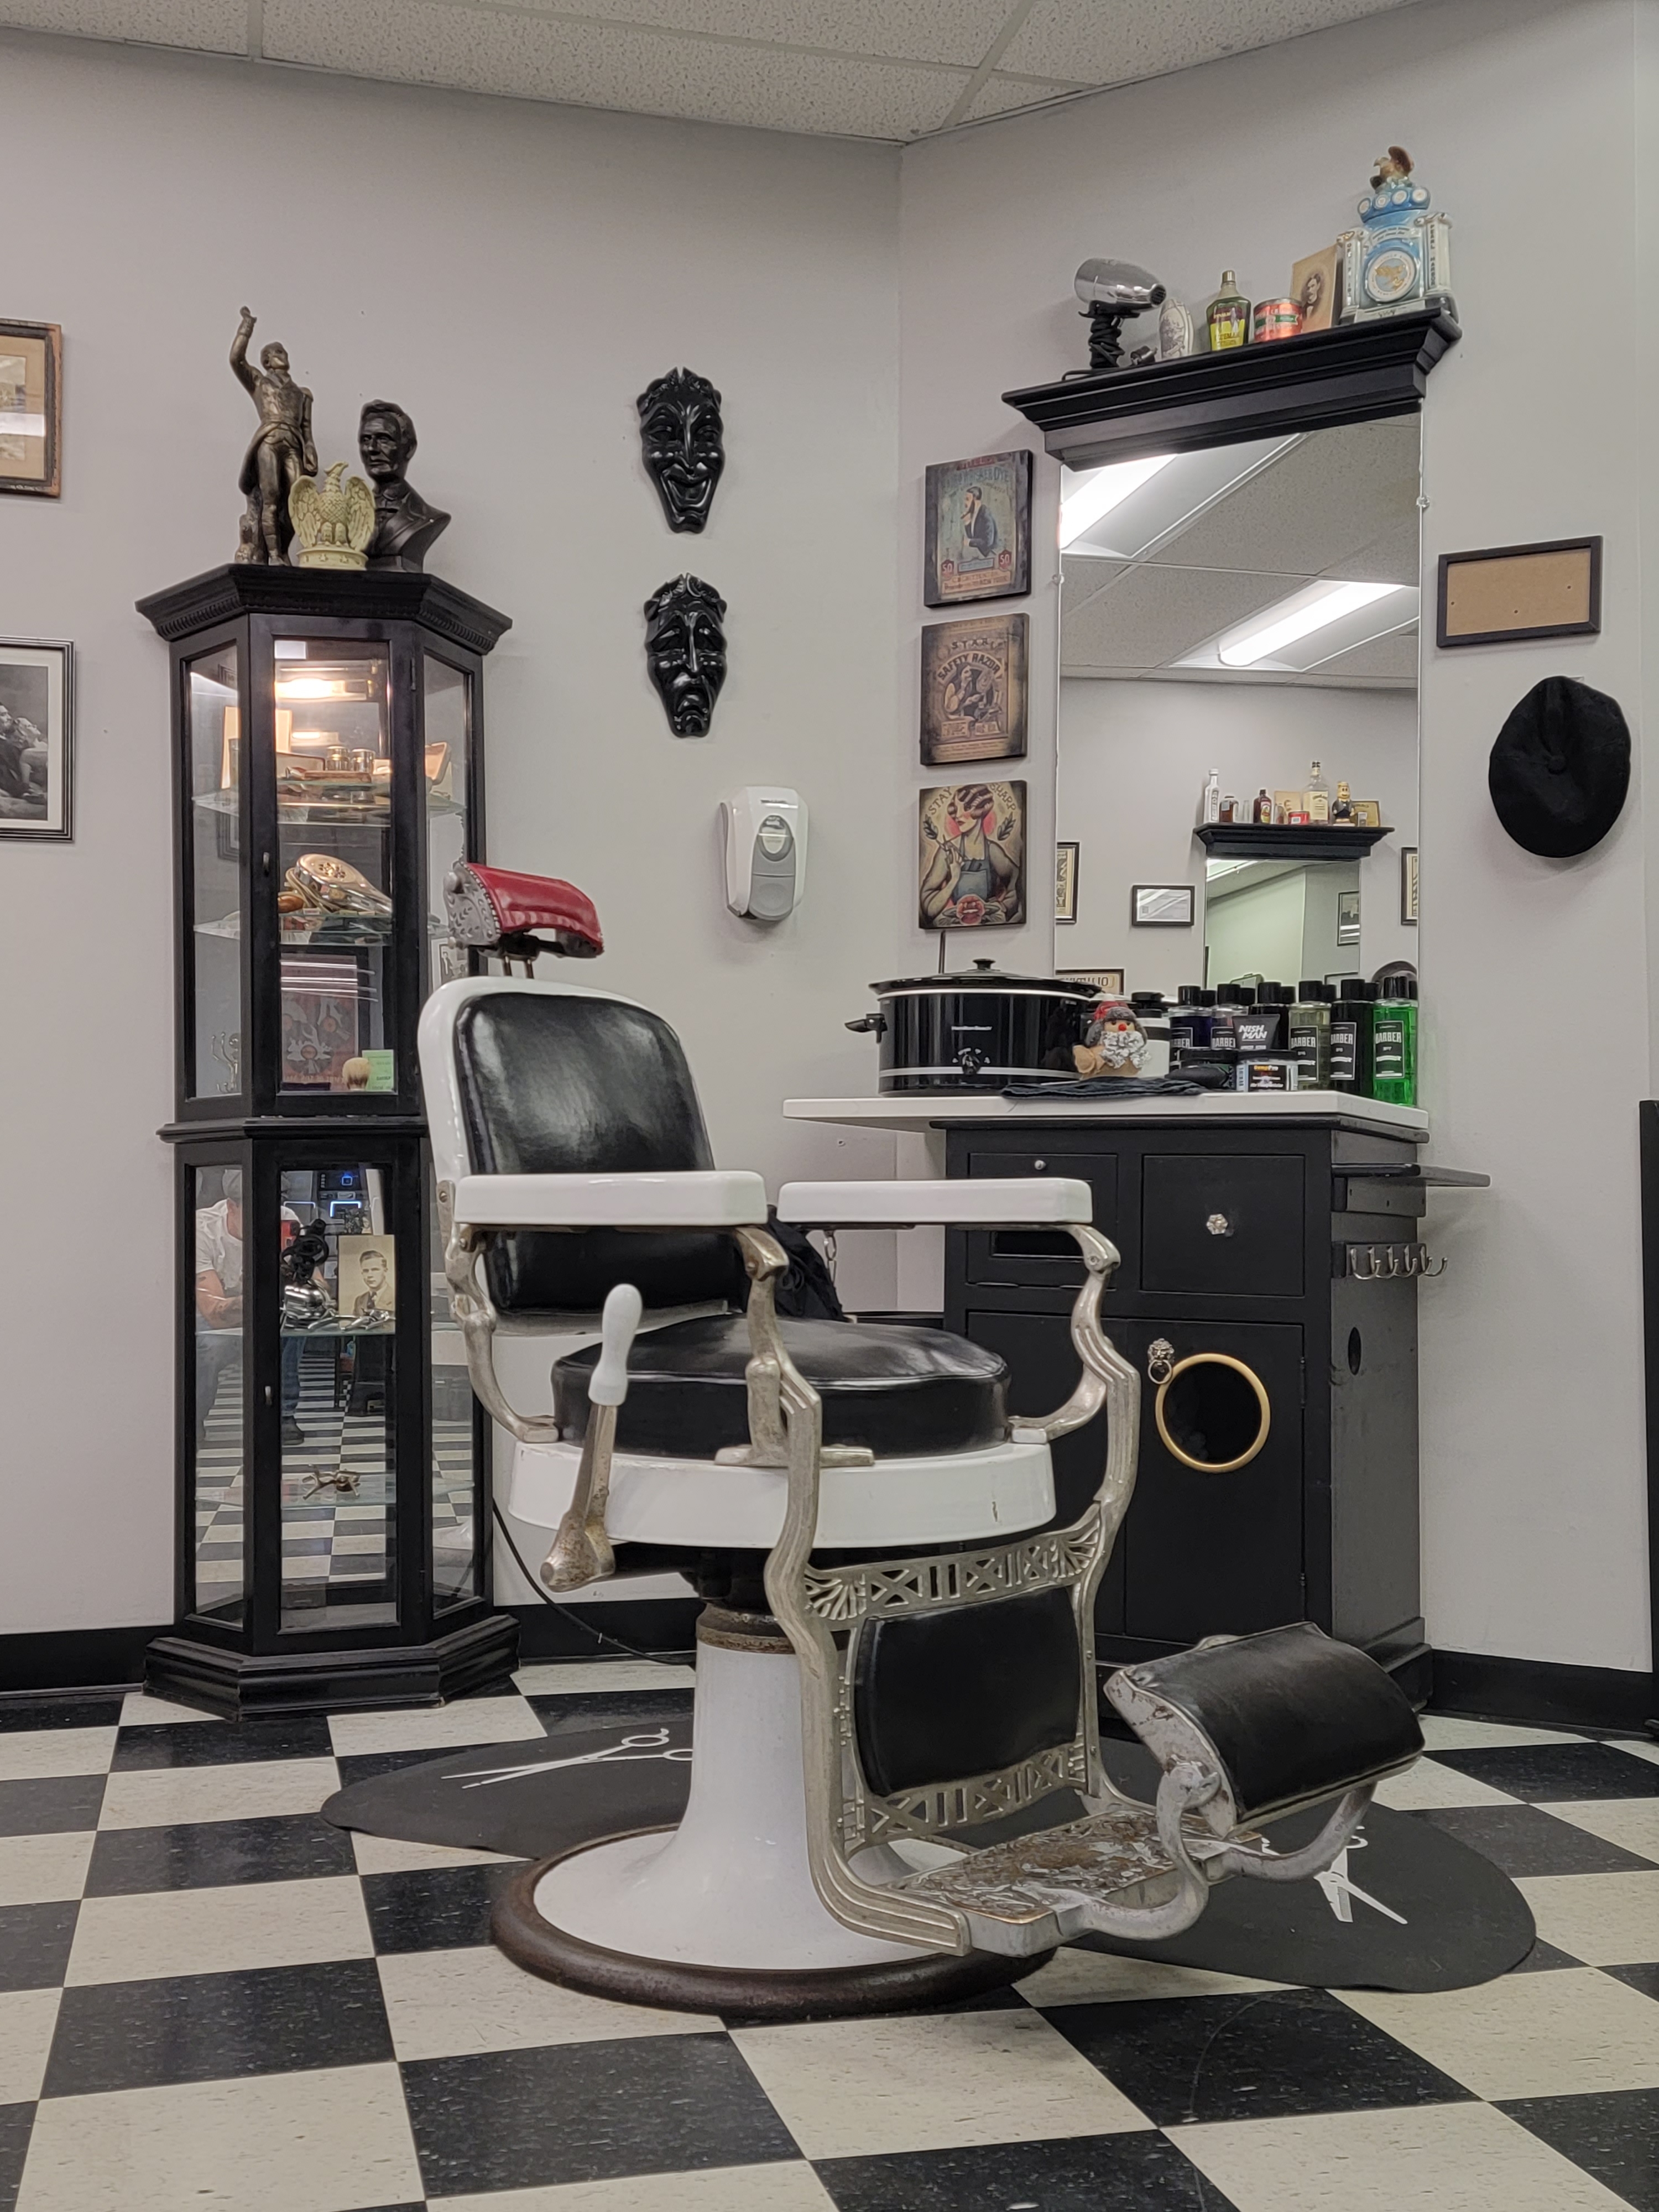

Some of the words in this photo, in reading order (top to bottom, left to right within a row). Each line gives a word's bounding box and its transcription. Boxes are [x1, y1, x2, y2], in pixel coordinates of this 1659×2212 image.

[994, 466, 1009, 482] DYE
[999, 554, 1010, 565] 50
[942, 562, 953, 573] 50
[951, 638, 989, 650] STAR
[937, 653, 969, 681] SAFETY
[972, 653, 1001, 675] RAZOR
[928, 786, 953, 815] STAY
[989, 782, 1016, 811] SHARP
